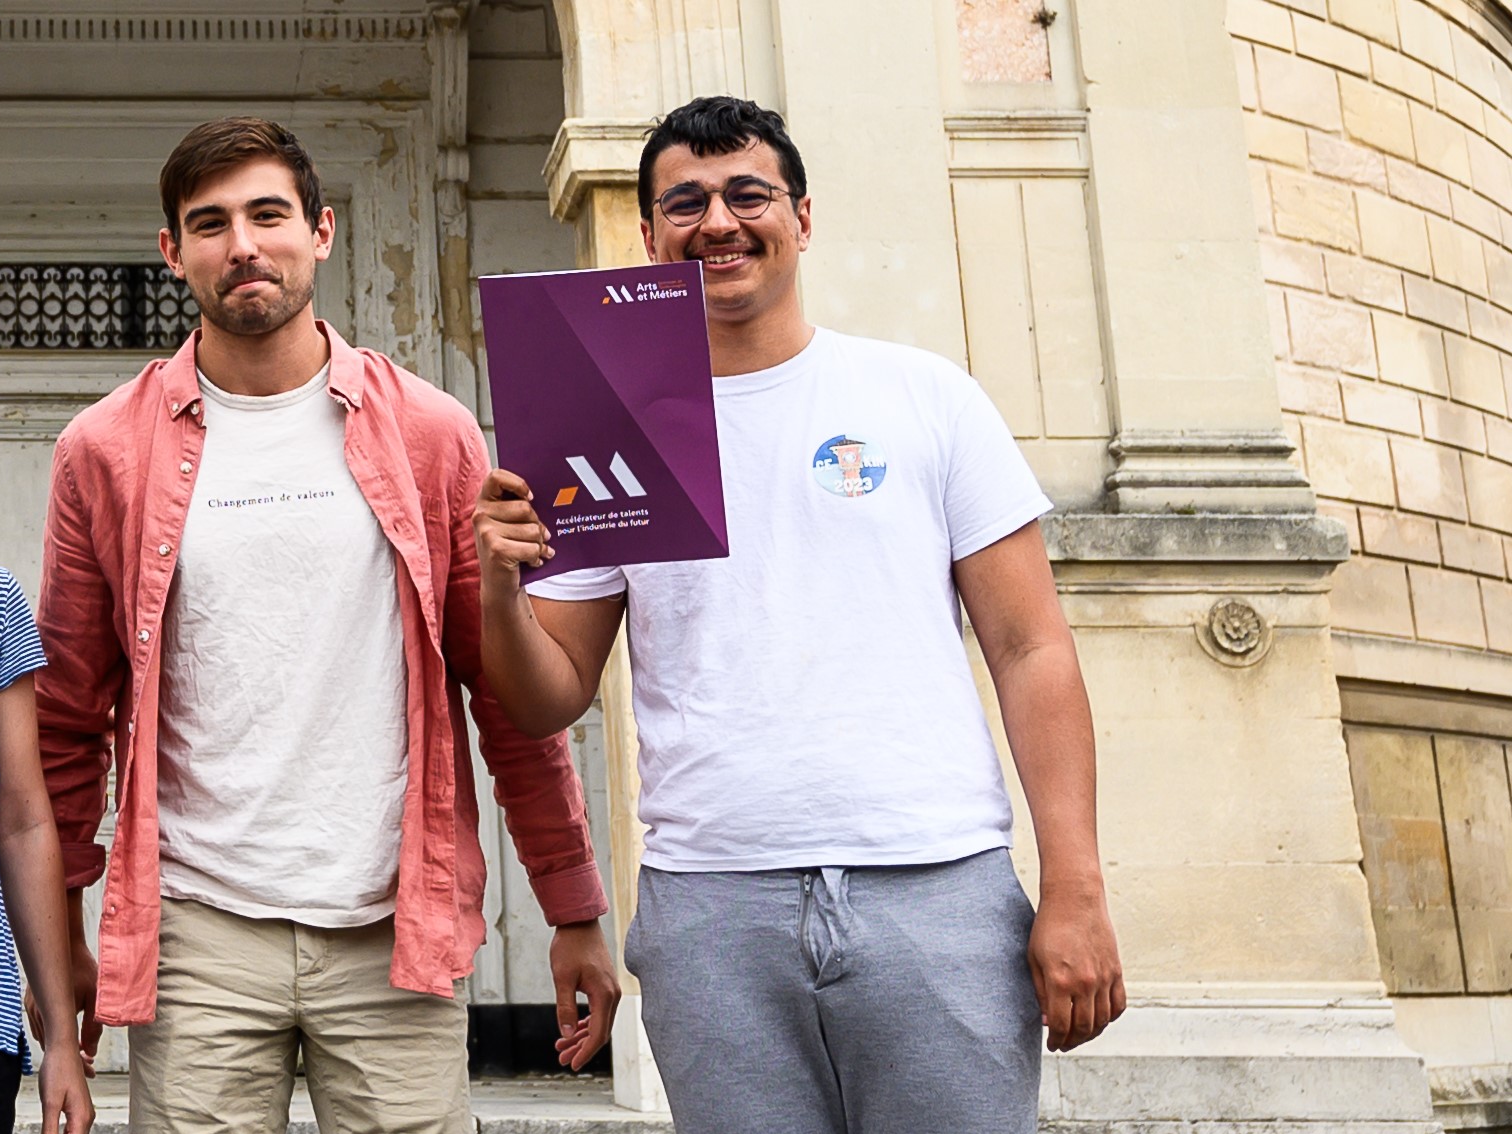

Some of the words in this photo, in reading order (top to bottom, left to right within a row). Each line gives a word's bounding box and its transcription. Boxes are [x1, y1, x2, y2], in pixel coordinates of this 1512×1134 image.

[636, 282, 657, 292] Arts
[637, 292, 648, 301] et
[650, 289, 688, 300] Métiers
[834, 476, 873, 492] 2023
[208, 496, 274, 508] Changement
[279, 493, 291, 502] de
[297, 490, 335, 500] valeurs
[556, 513, 606, 526] Accélérateur
[608, 511, 618, 519] de
[620, 508, 649, 518] talents
[557, 526, 575, 537] pour
[577, 521, 616, 533] l'industrie
[618, 519, 628, 528] du
[630, 518, 650, 527] futur
